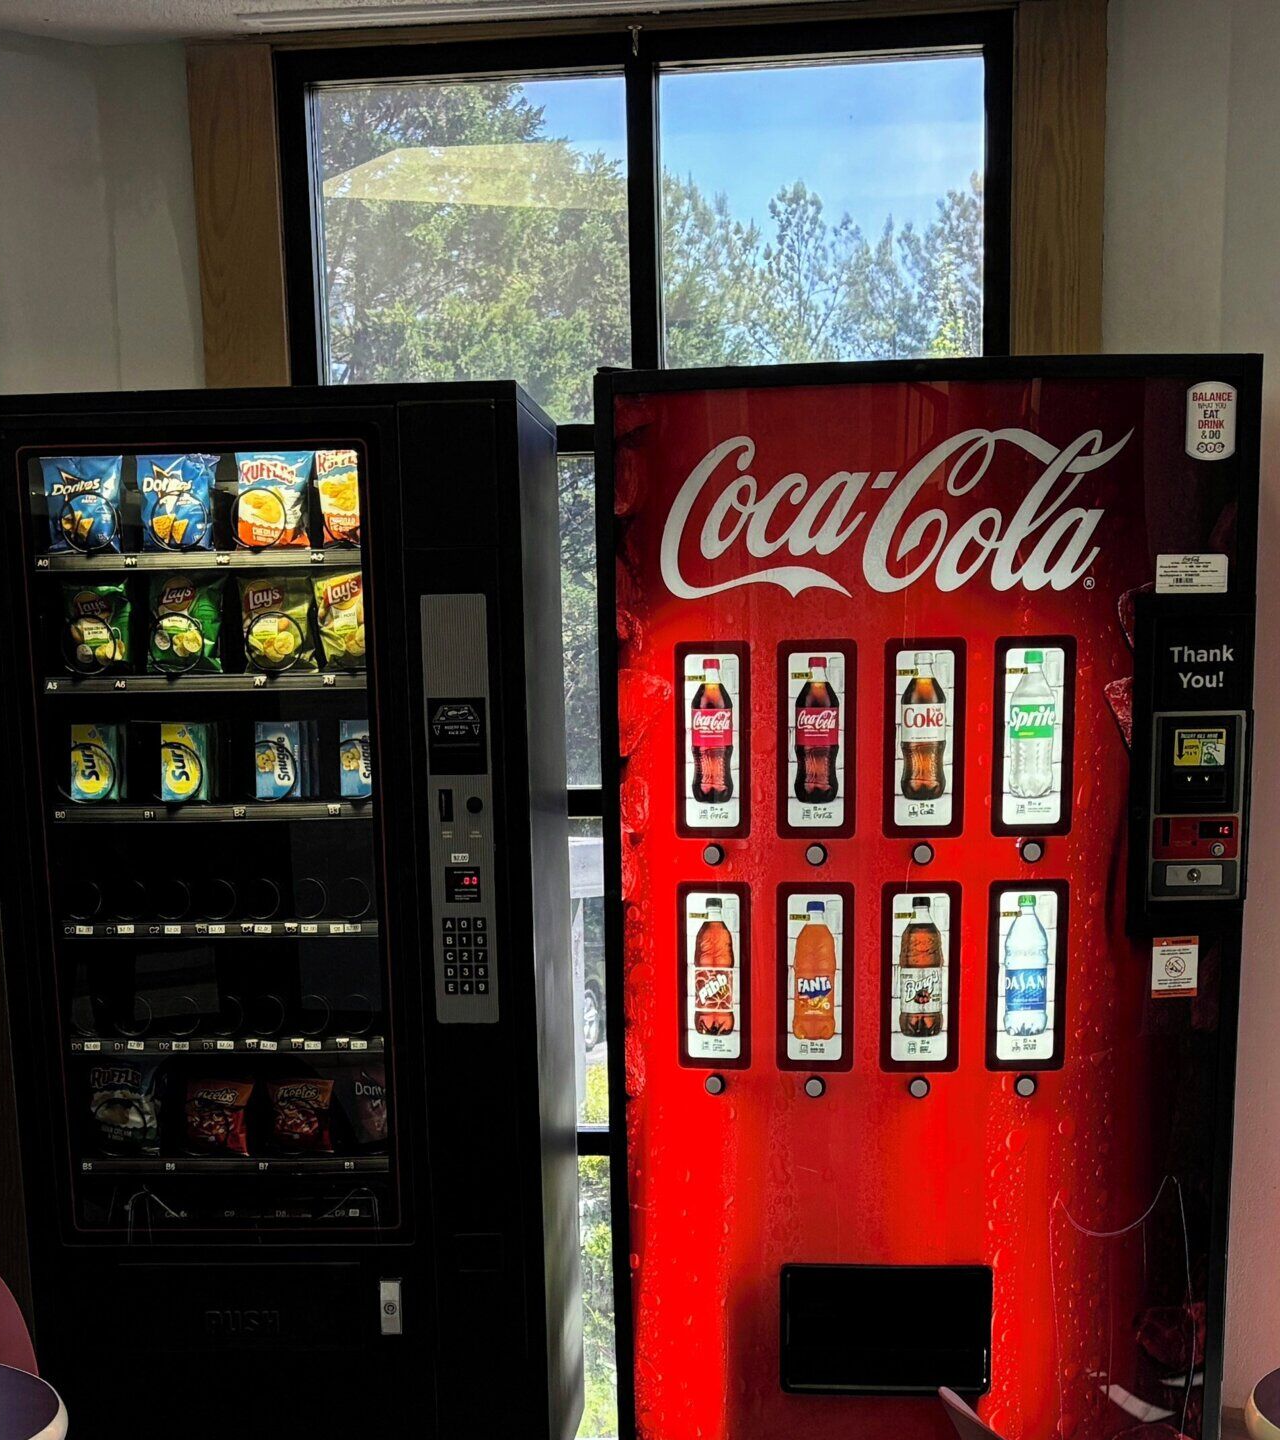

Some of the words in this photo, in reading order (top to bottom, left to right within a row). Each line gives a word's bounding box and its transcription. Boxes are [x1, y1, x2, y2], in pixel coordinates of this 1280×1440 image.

[1192, 392, 1233, 401] BALANCE
[1203, 410, 1220, 418] EAT
[1198, 420, 1225, 429] DRINK
[1201, 430, 1207, 439] &
[1209, 430, 1221, 439] DO
[52, 478, 101, 496] Doritos
[660, 426, 1135, 600] Coca-Cola
[37, 559, 49, 567] A0
[163, 586, 192, 604] Lay's
[249, 588, 282, 610] Lay's
[327, 579, 360, 605] Lay's
[1170, 645, 1234, 663] Thank
[47, 681, 57, 690] A5
[1178, 671, 1224, 689] You!
[693, 711, 731, 730] Coca-Cola
[797, 710, 837, 730] Coca-Cola
[904, 707, 944, 728] Coke
[1009, 705, 1056, 731] Sprite
[234, 809, 245, 817] B2
[149, 926, 160, 934] C2
[699, 973, 727, 1004] Pibb
[798, 976, 831, 992] FANTA
[159, 1042, 170, 1050] D2
[82, 1163, 93, 1171] B5
[205, 1310, 280, 1335] PUSH
